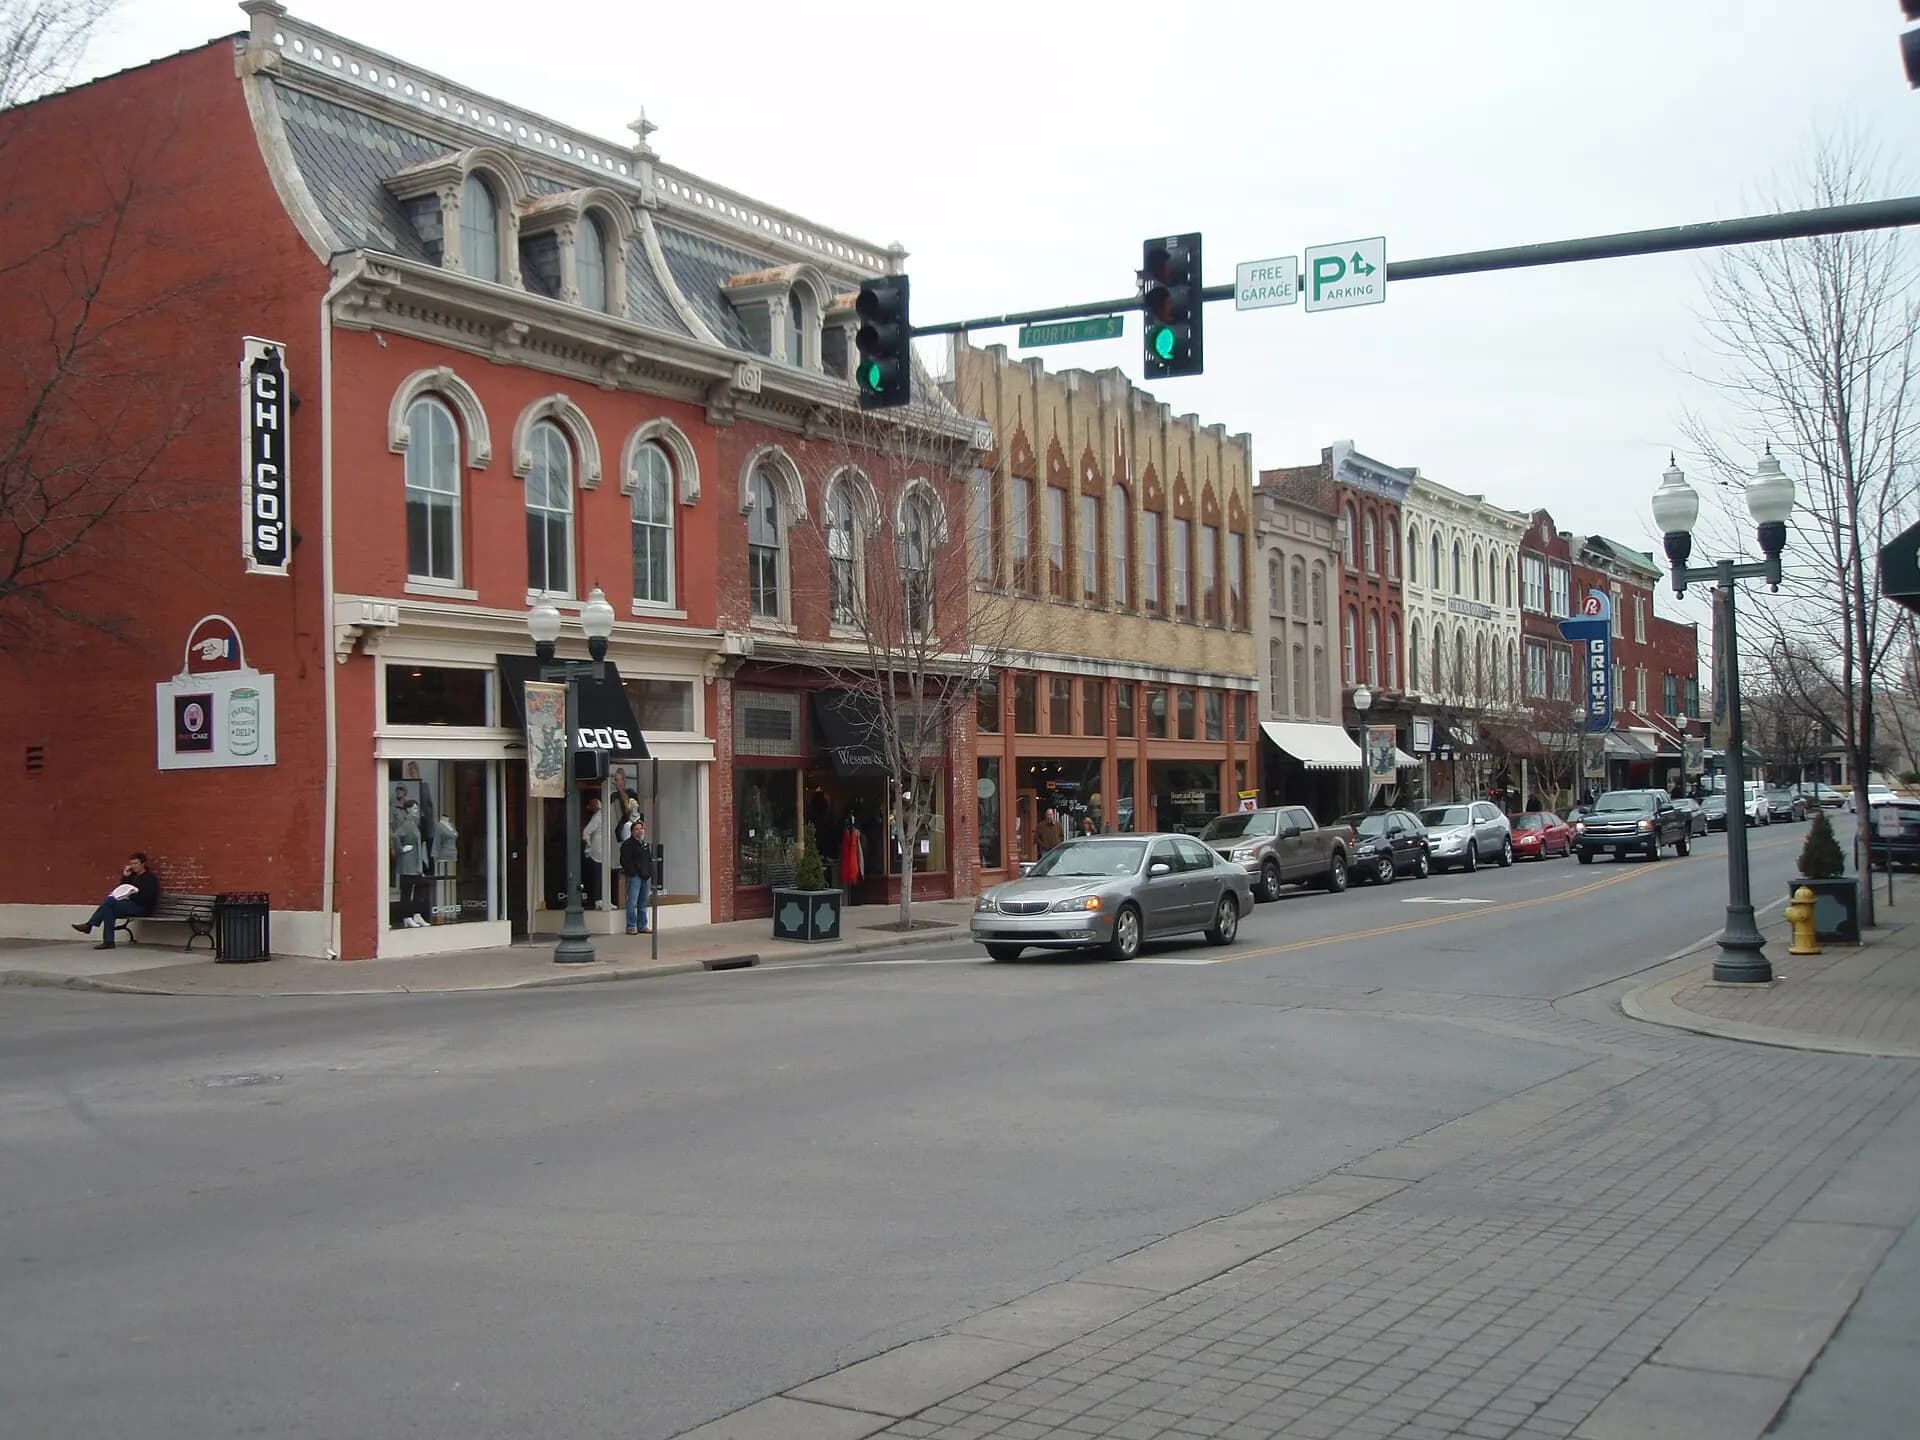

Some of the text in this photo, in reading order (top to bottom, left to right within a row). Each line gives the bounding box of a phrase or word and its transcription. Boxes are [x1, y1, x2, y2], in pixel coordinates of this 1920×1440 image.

[1251, 266, 1282, 282] FREE
[1313, 256, 1374, 302] PARKING
[1241, 283, 1292, 301] GARAGE
[1024, 324, 1076, 345] FOURTH
[1107, 319, 1116, 335] S
[256, 372, 284, 551] CHICO'S
[1591, 639, 1607, 715] GRAY'S
[235, 727, 251, 737] DELI
[564, 726, 632, 750] CO'S
